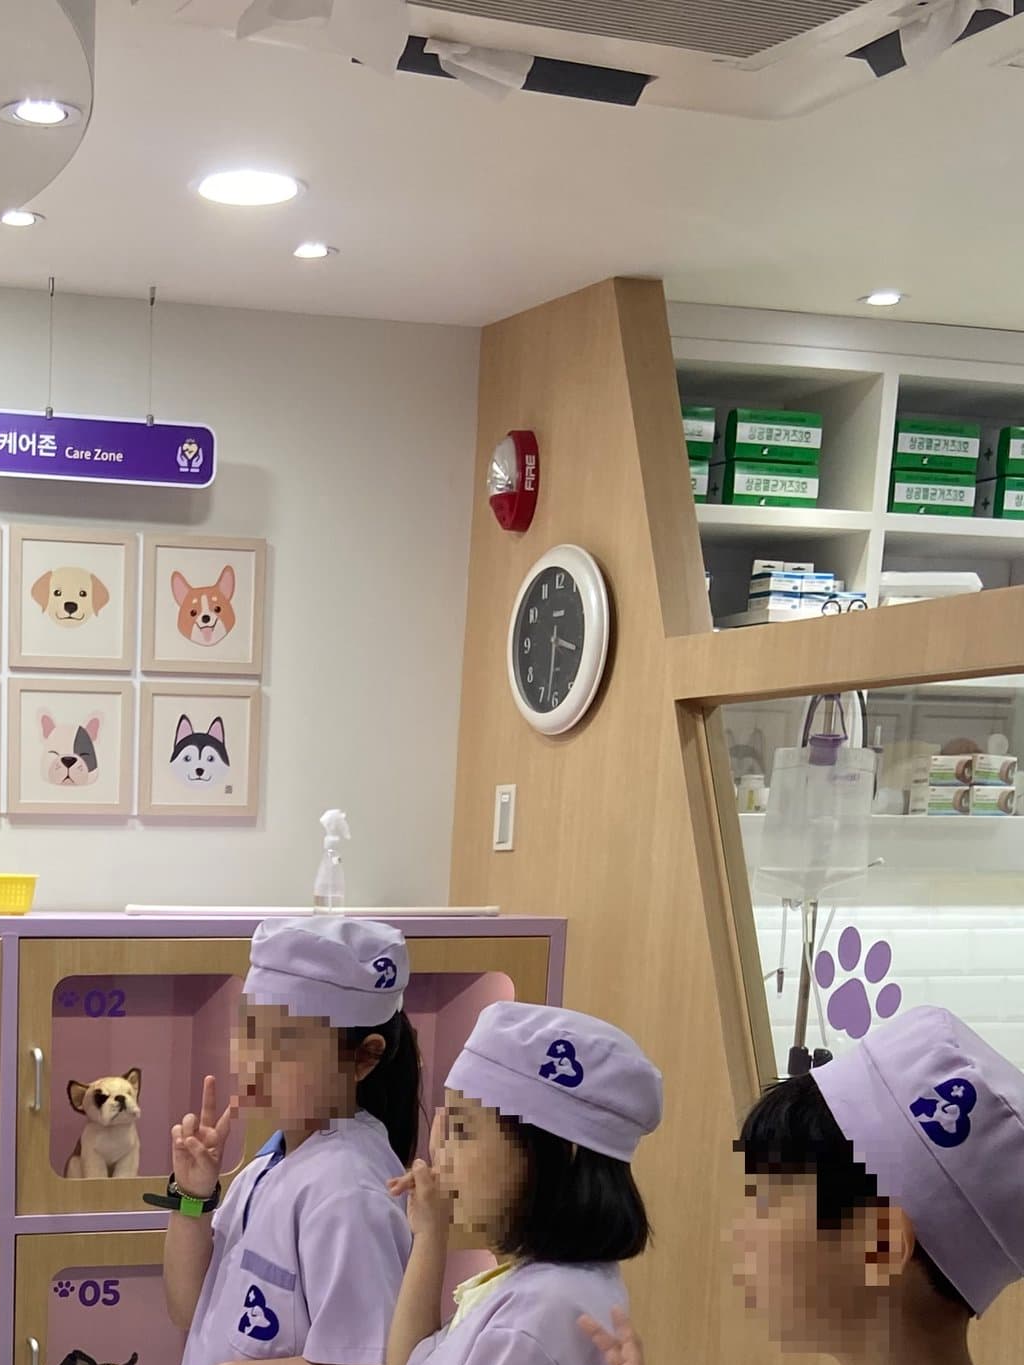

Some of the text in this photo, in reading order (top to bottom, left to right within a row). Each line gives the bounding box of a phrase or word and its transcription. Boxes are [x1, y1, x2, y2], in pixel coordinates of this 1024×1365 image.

[65, 447, 91, 461] Care
[94, 449, 124, 462] Zone
[524, 454, 536, 491] FIRE
[556, 573, 565, 589] 12
[542, 583, 548, 600] 11
[529, 607, 538, 624] 10
[523, 638, 531, 654] 9
[527, 666, 534, 683] 8
[538, 686, 545, 703] 7
[551, 691, 559, 708] 6
[84, 990, 126, 1018] 02
[78, 1279, 121, 1306] 05
